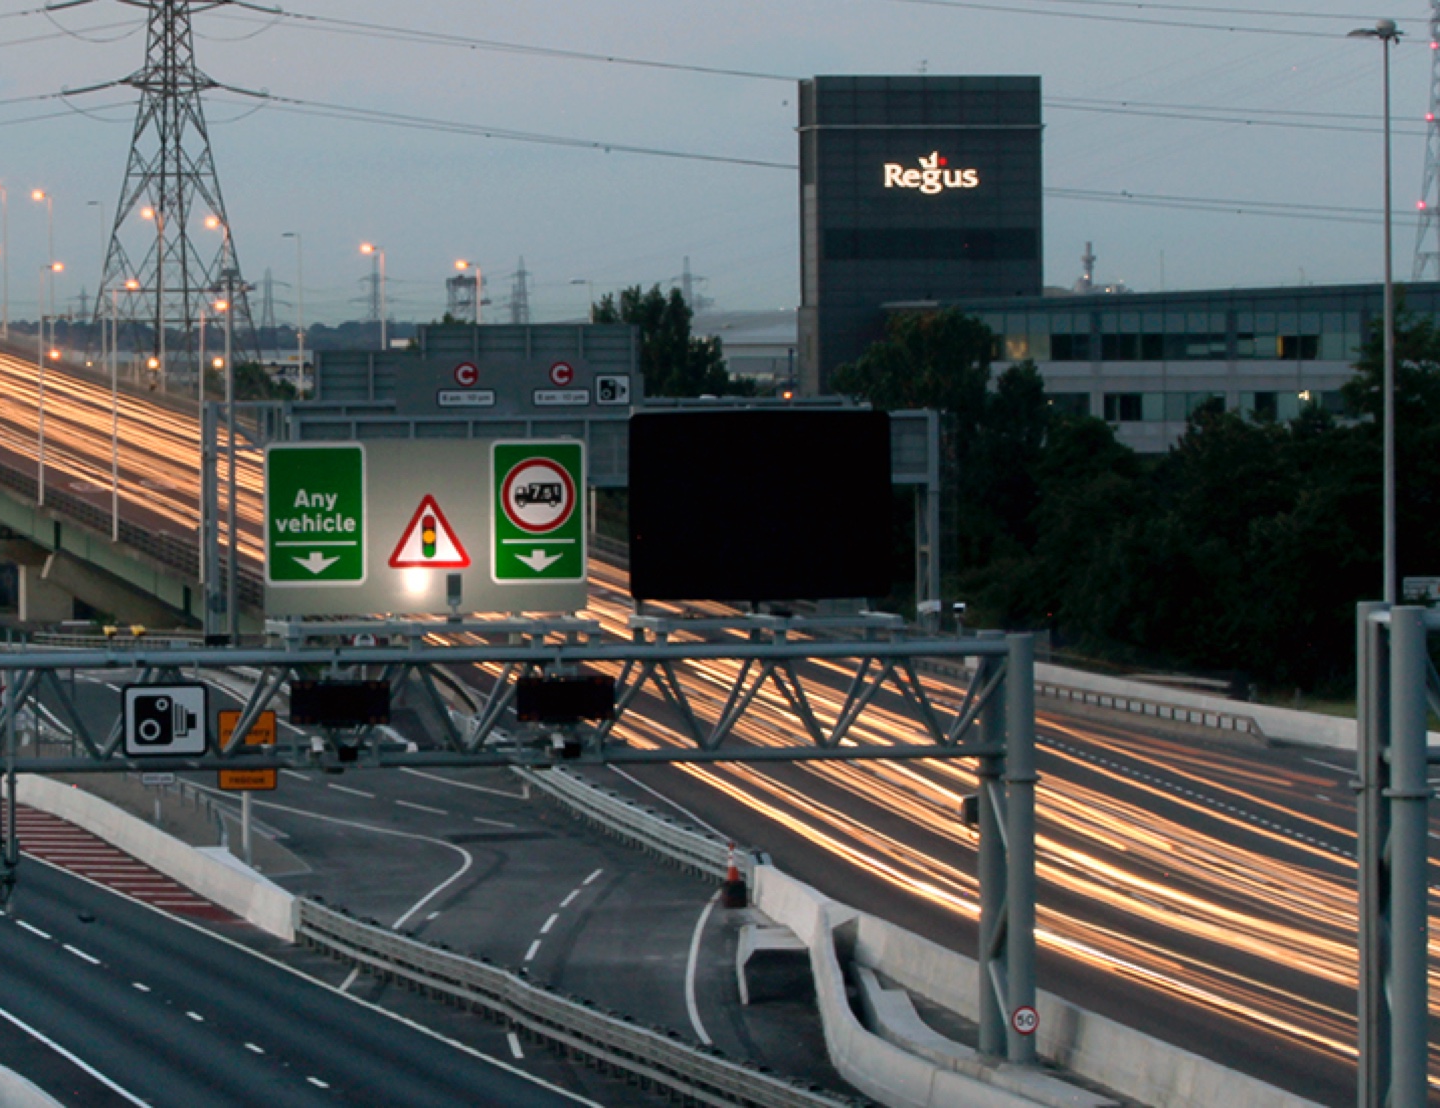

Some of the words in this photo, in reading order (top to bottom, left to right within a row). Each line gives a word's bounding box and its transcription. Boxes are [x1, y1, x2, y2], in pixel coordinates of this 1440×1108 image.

[884, 162, 979, 194] Regus
[457, 365, 475, 385] C
[551, 365, 570, 385] C
[293, 488, 338, 511] Any
[275, 512, 357, 533] vehicle
[1017, 1013, 1035, 1027] 50
